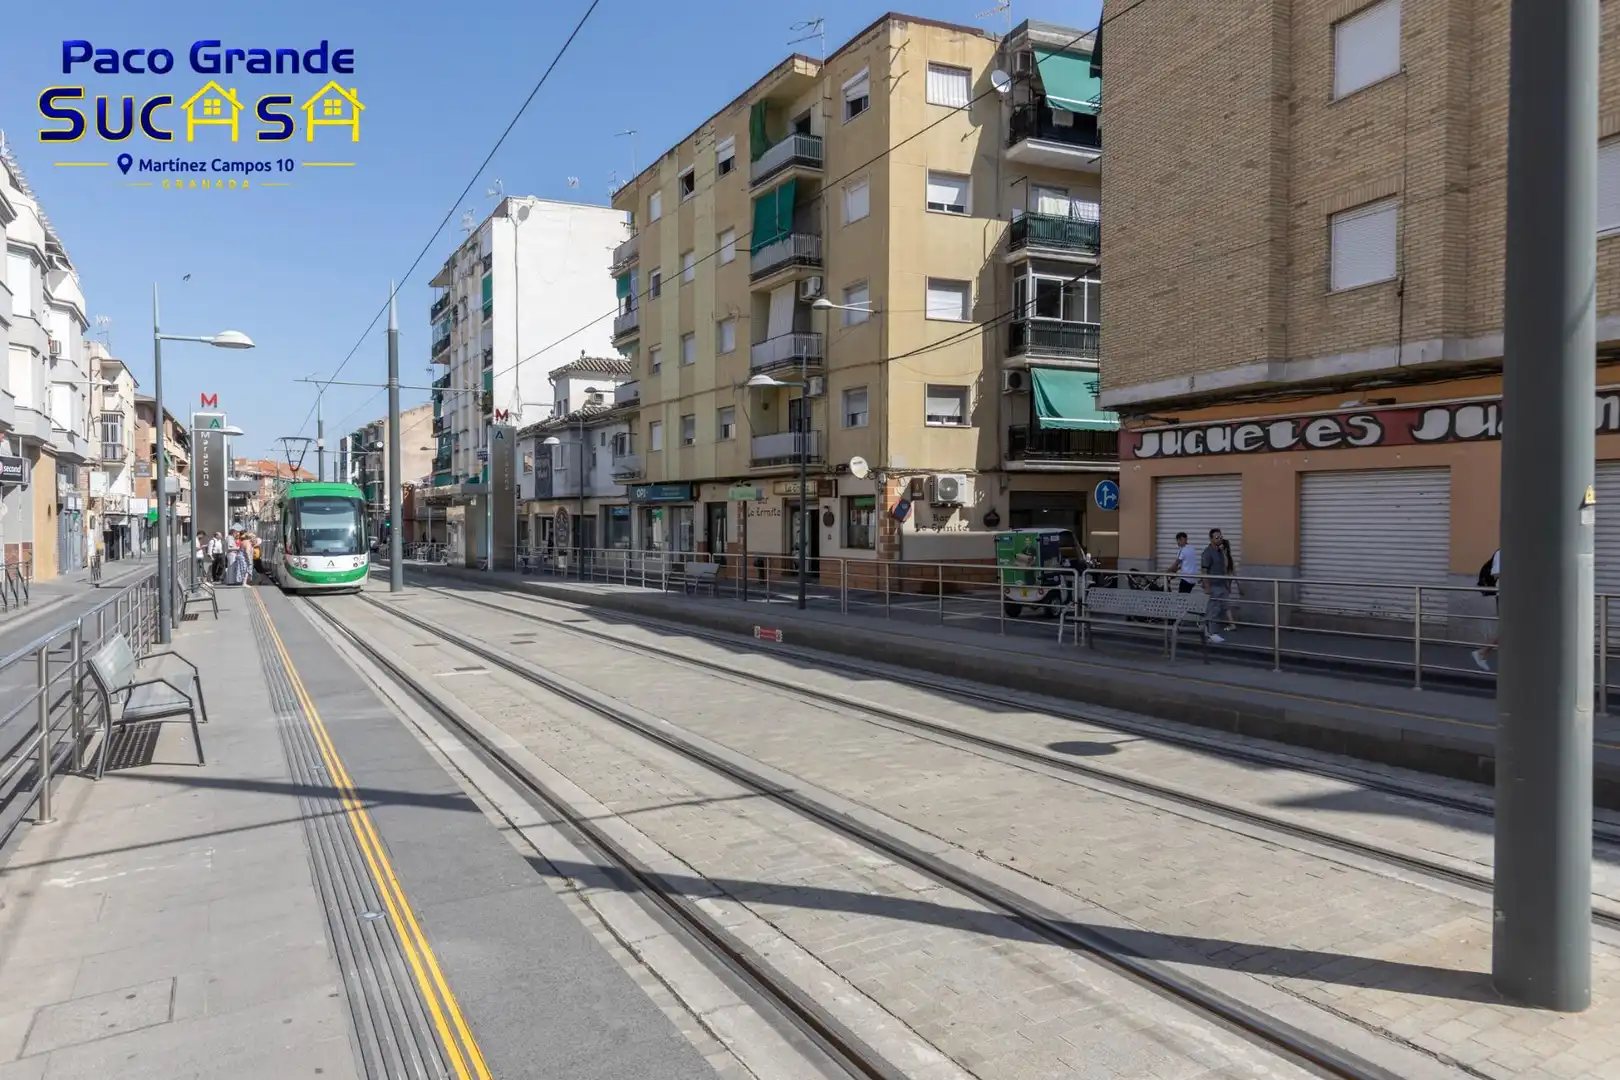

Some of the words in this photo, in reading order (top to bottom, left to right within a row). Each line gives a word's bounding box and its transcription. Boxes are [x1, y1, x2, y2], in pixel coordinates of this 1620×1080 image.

[200, 392, 218, 408] M
[495, 408, 509, 422] M
[200, 431, 210, 487] Maracena
[756, 506, 781, 517] Ermita
